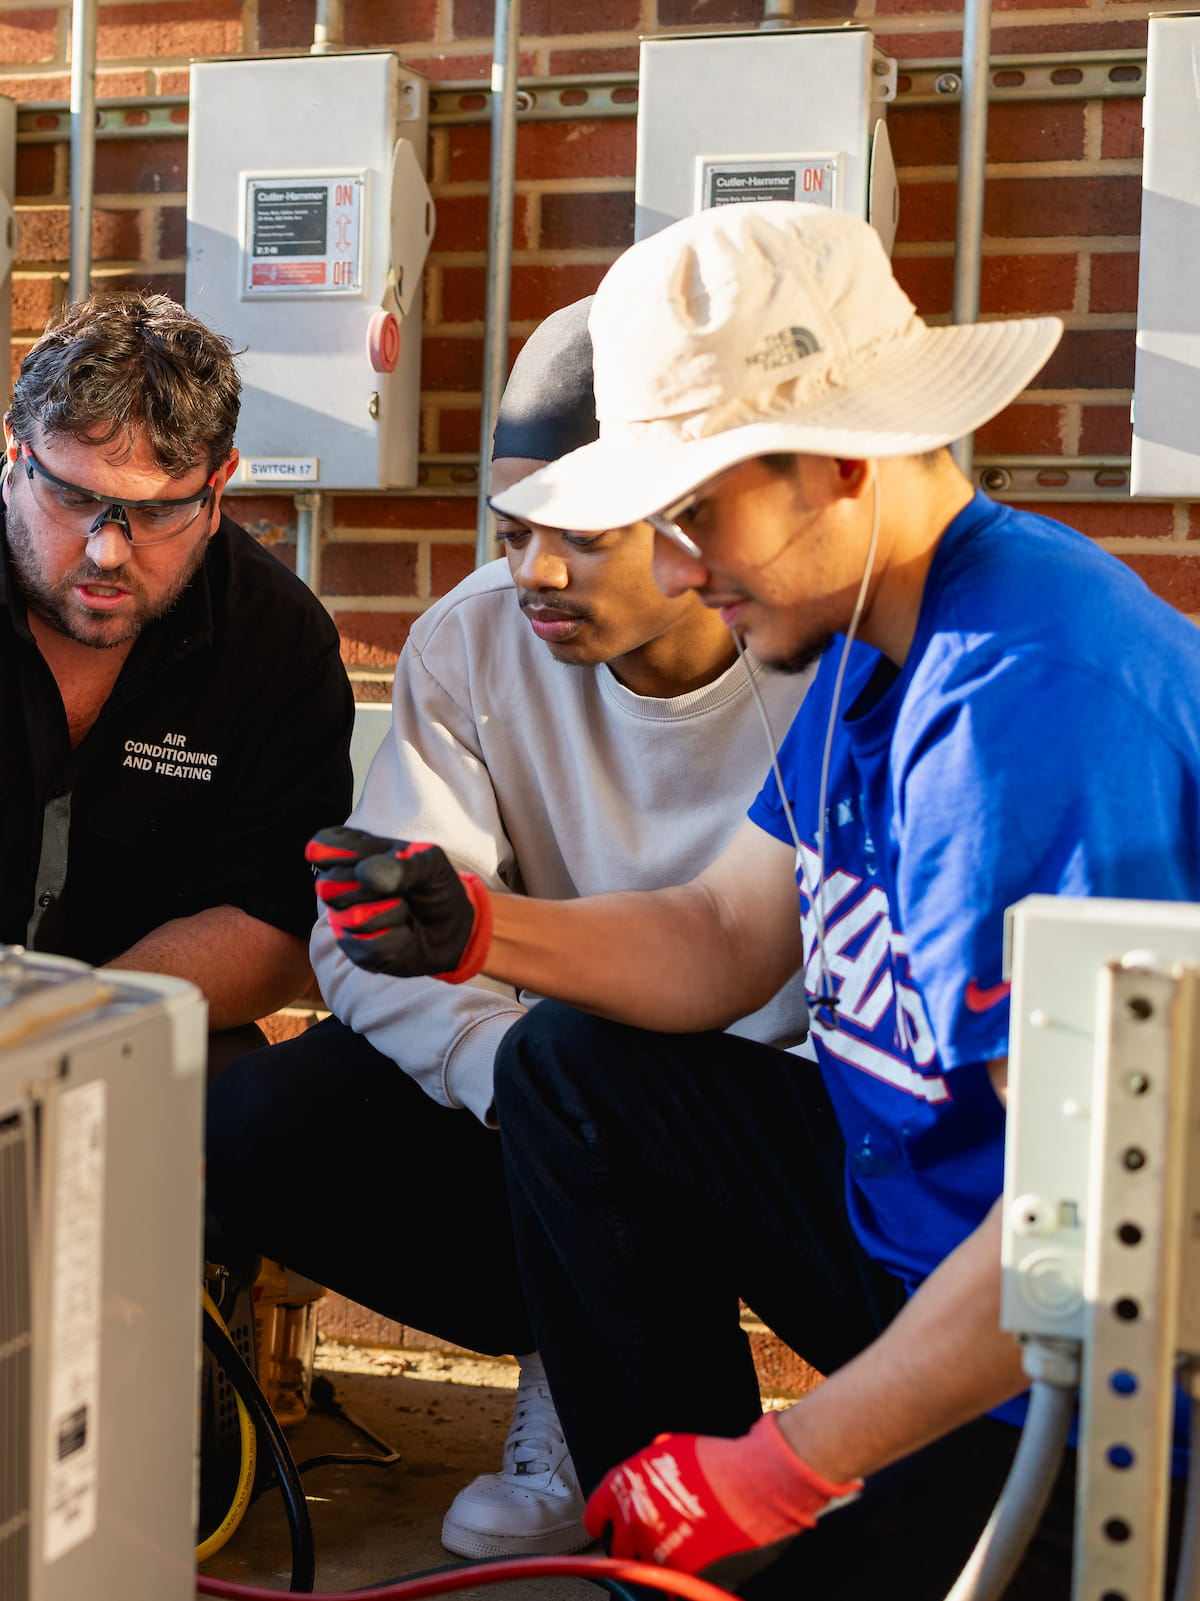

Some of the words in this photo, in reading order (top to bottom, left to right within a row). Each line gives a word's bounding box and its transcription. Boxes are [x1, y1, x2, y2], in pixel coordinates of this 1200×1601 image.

[803, 168, 823, 192] ON
[334, 184, 353, 206] ON
[333, 261, 352, 285] OFF
[251, 464, 295, 474] SWITCH
[300, 464, 312, 474] 17
[162, 732, 187, 747] AIR
[124, 740, 218, 767] CONDITIONING
[123, 755, 153, 771] AND
[155, 762, 212, 781] HEATING
